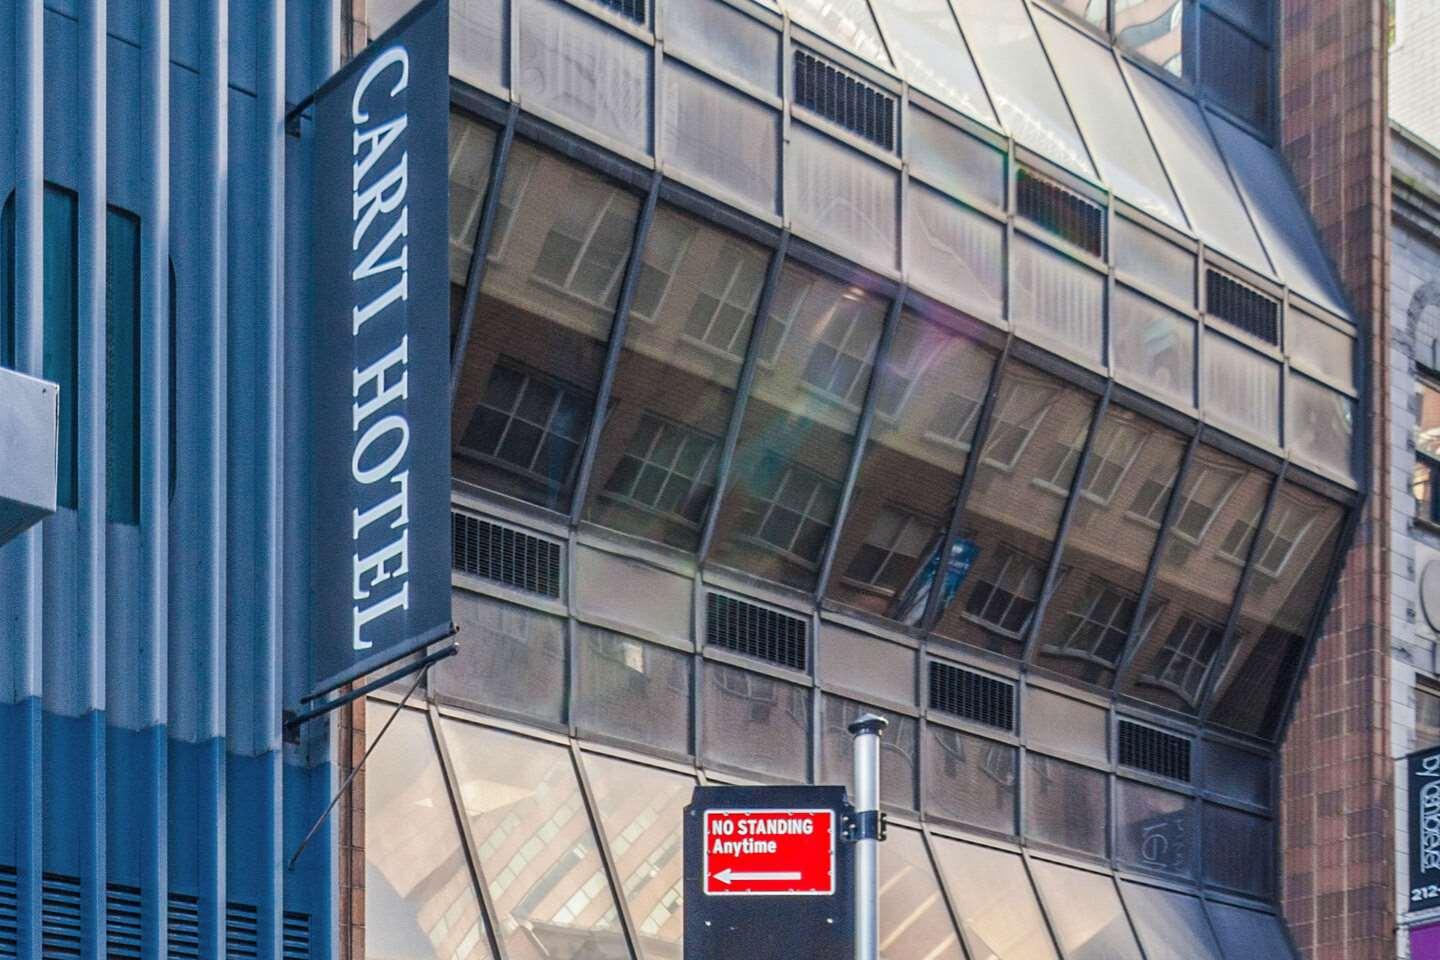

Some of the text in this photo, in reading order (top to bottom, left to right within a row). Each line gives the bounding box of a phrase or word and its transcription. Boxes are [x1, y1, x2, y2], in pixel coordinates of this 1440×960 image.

[352, 46, 410, 650] CARVI HOTEL
[712, 818, 814, 835] NO STANDING
[712, 838, 777, 858] Anytime
